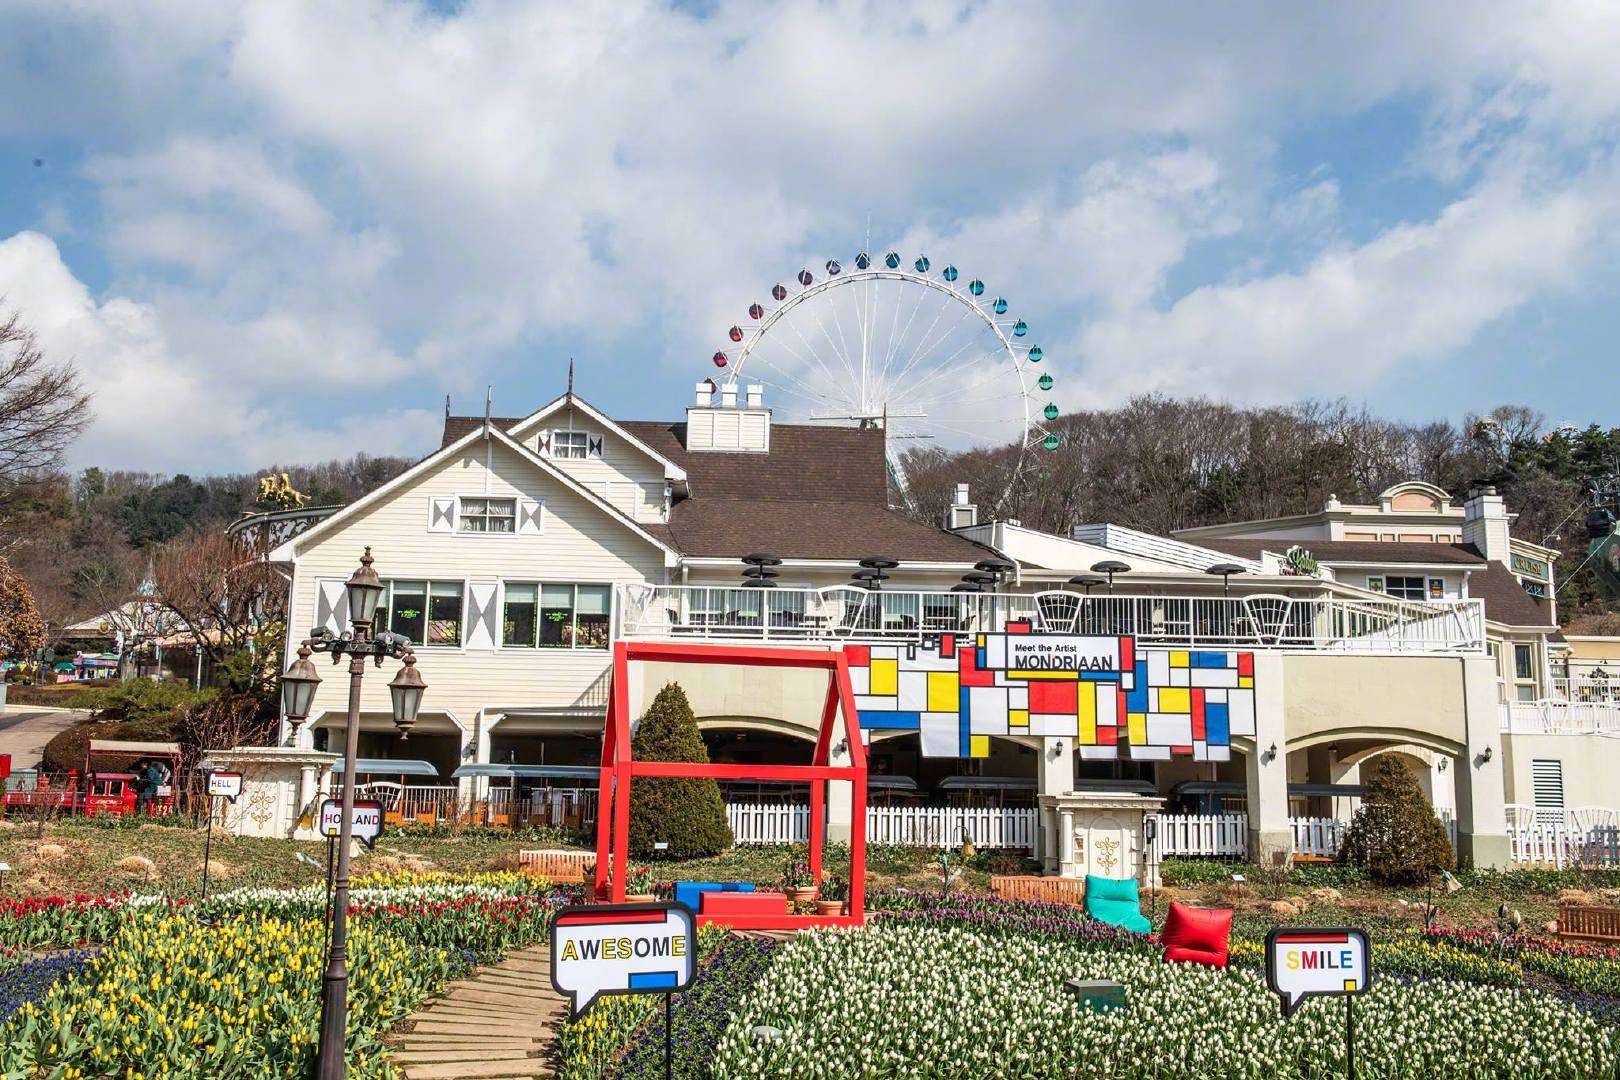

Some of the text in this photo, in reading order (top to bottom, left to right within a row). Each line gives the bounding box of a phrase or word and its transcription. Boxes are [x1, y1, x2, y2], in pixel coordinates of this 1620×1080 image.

[1015, 644, 1077, 653] Meet the Artist
[1015, 653, 1113, 671] MONDRIAAN
[561, 936, 686, 961] AWESOME
[1286, 950, 1353, 970] SMILE
